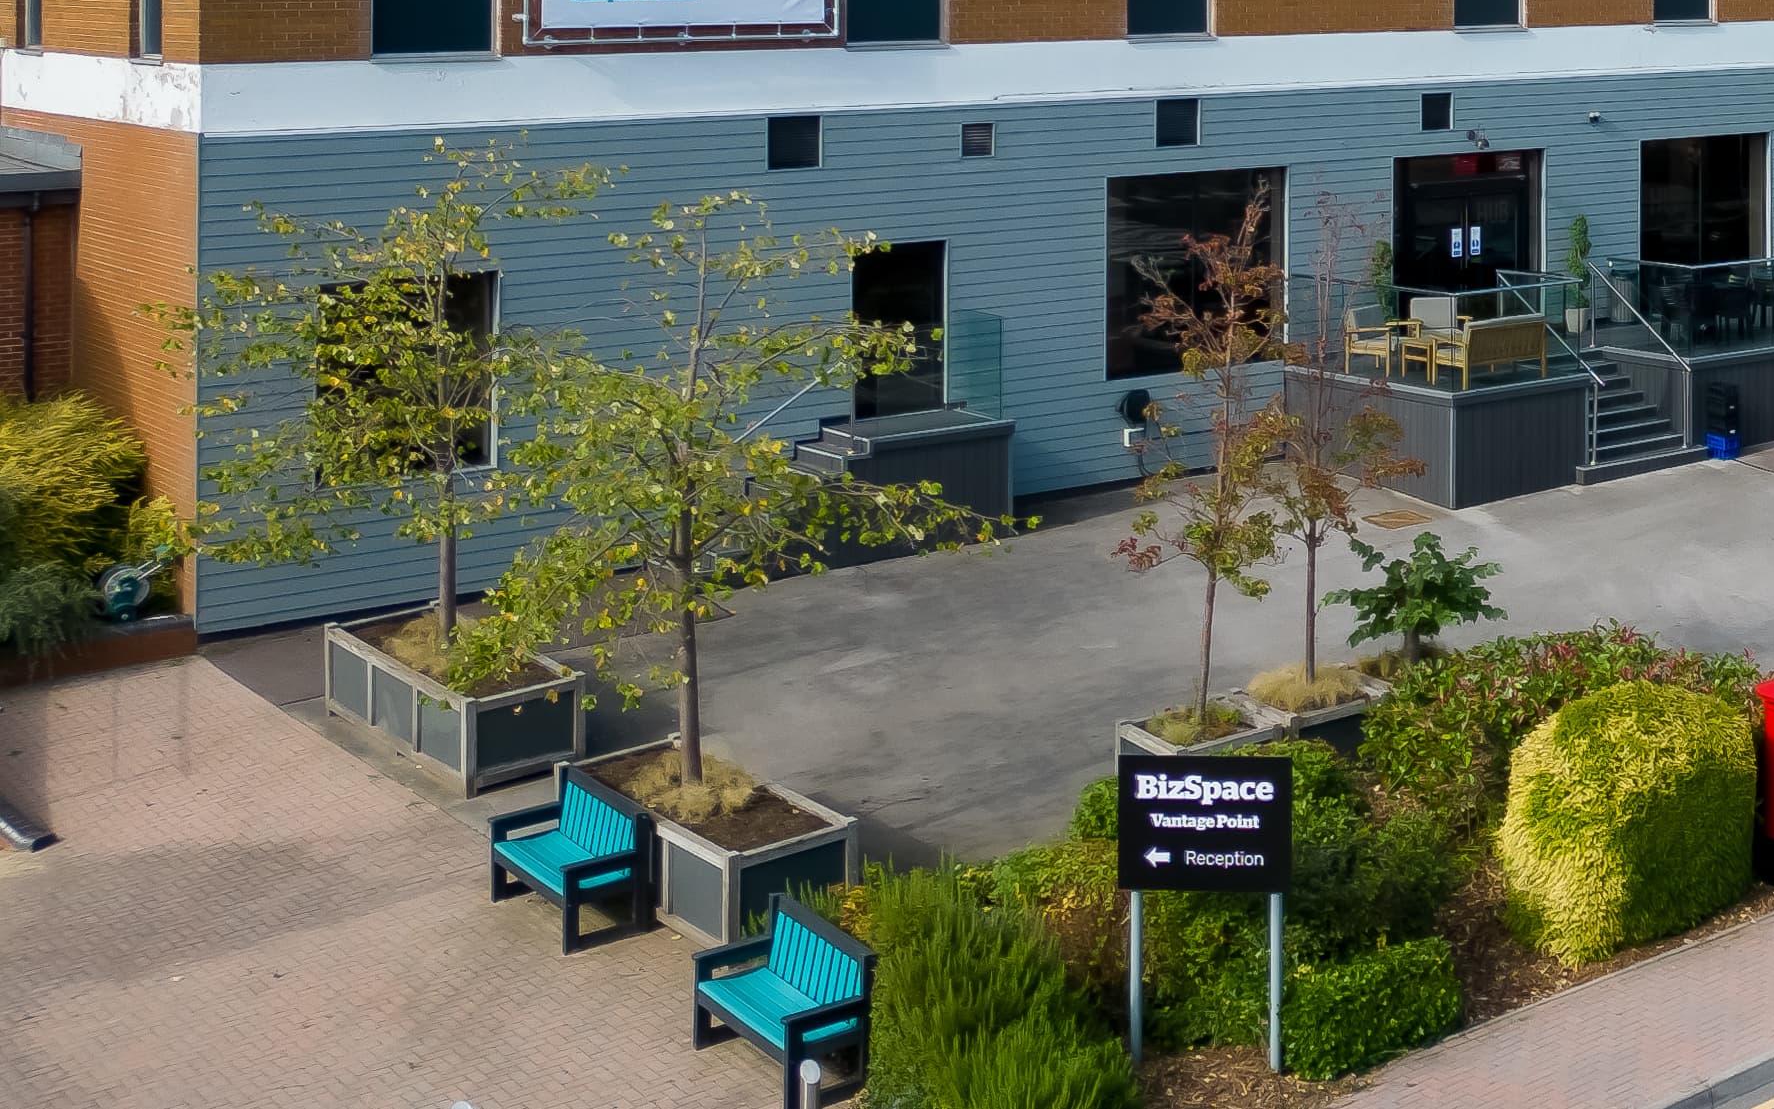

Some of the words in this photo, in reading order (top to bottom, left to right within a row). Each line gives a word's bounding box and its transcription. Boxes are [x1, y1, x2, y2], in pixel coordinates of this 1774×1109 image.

[1135, 774, 1274, 805] BizSpace
[1150, 813, 1215, 830] Vantage
[1216, 814, 1260, 829] Point
[1184, 850, 1264, 868] Reception
